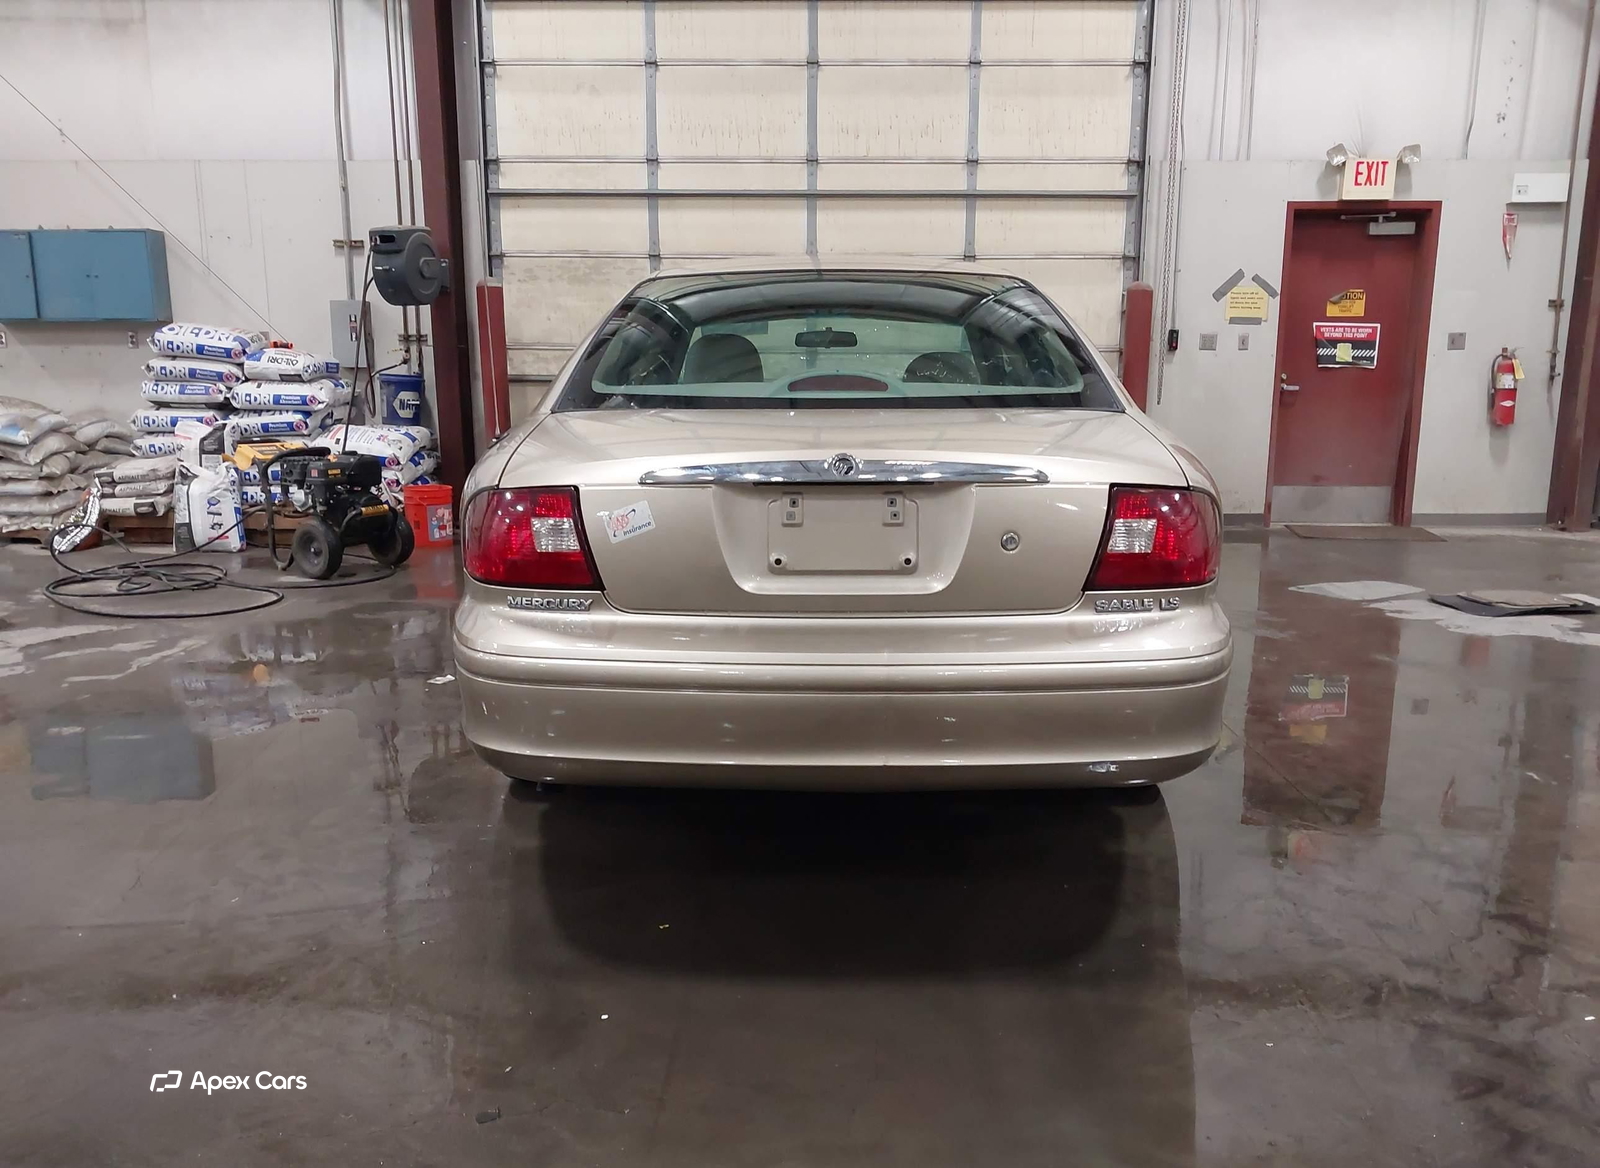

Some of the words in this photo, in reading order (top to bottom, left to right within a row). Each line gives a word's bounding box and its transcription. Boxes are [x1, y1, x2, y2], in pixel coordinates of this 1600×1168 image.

[1354, 161, 1389, 186] EXIT
[507, 595, 593, 611] MERCURY
[1095, 598, 1154, 612] SABLE
[1160, 597, 1180, 611] LS
